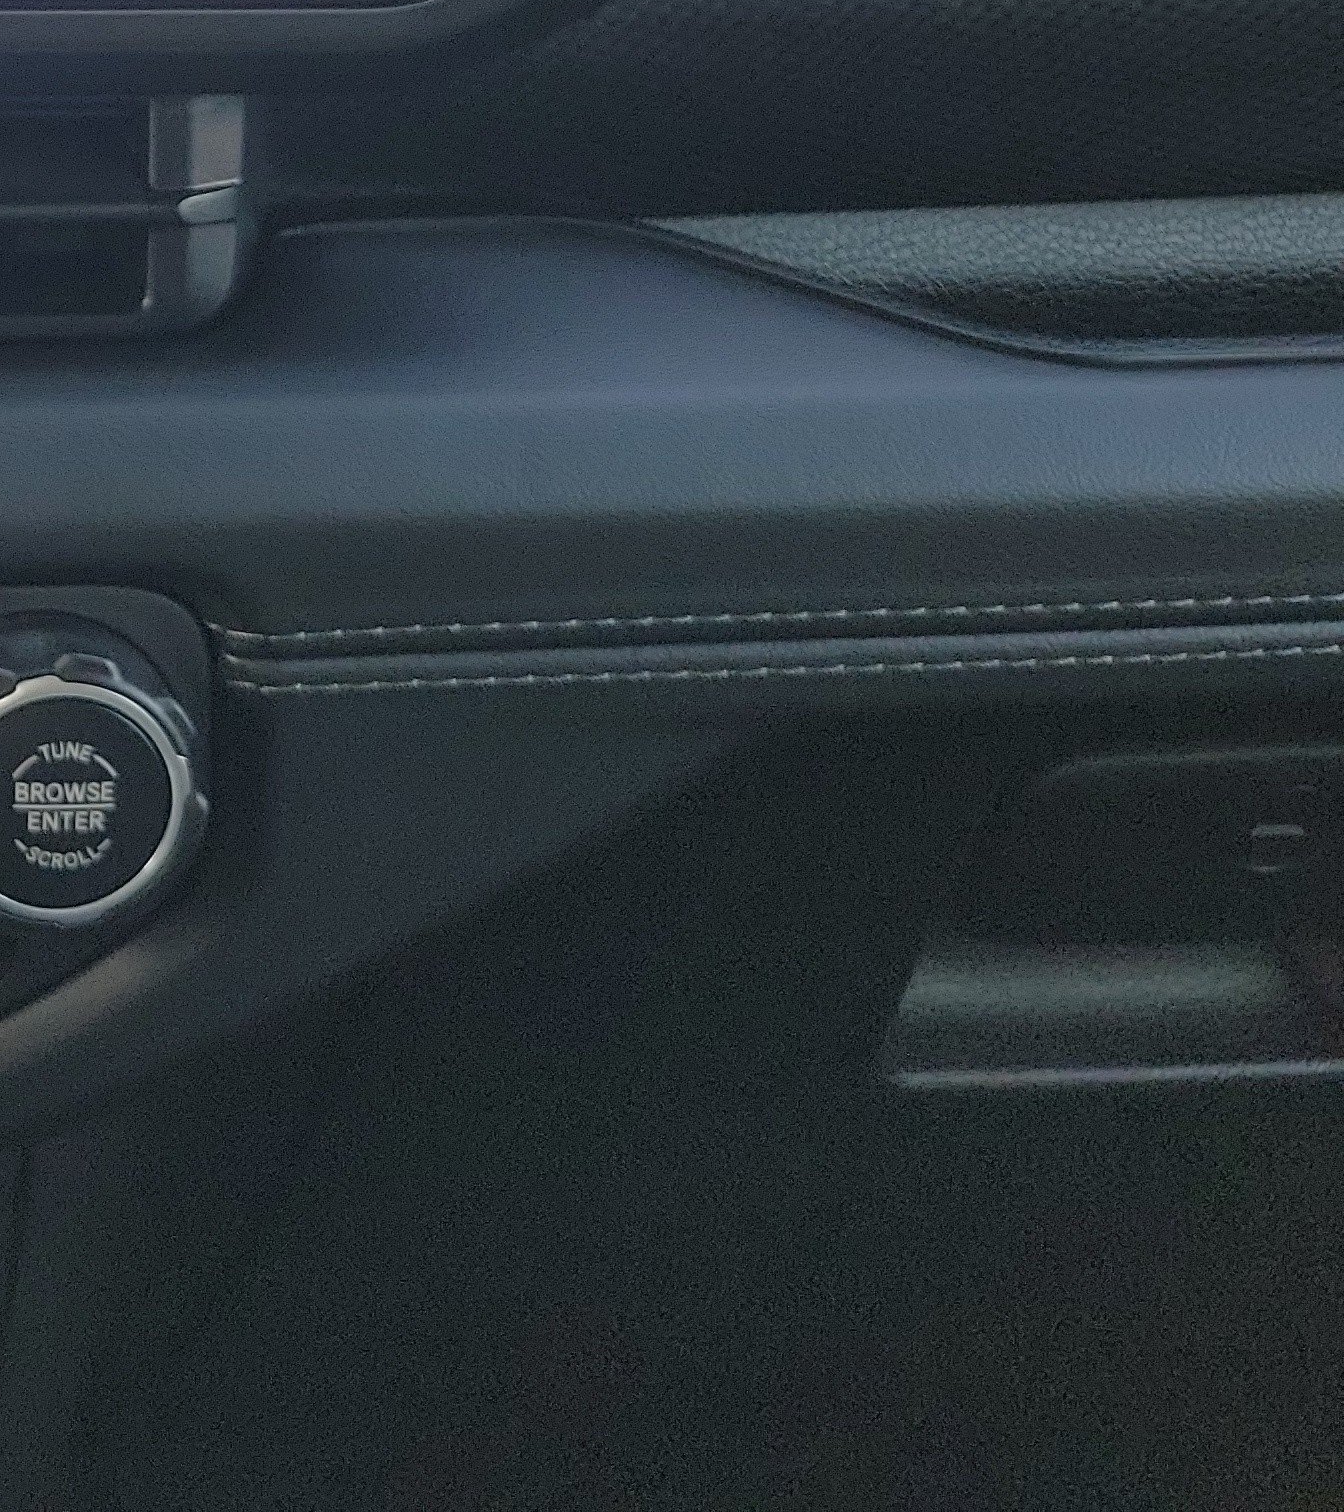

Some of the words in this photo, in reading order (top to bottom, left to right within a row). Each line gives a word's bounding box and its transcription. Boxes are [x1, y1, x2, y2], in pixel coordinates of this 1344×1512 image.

[37, 740, 98, 763] TUNE
[14, 781, 115, 804] BROWSE
[26, 810, 107, 833] ENTER
[25, 846, 103, 870] SCROLL
